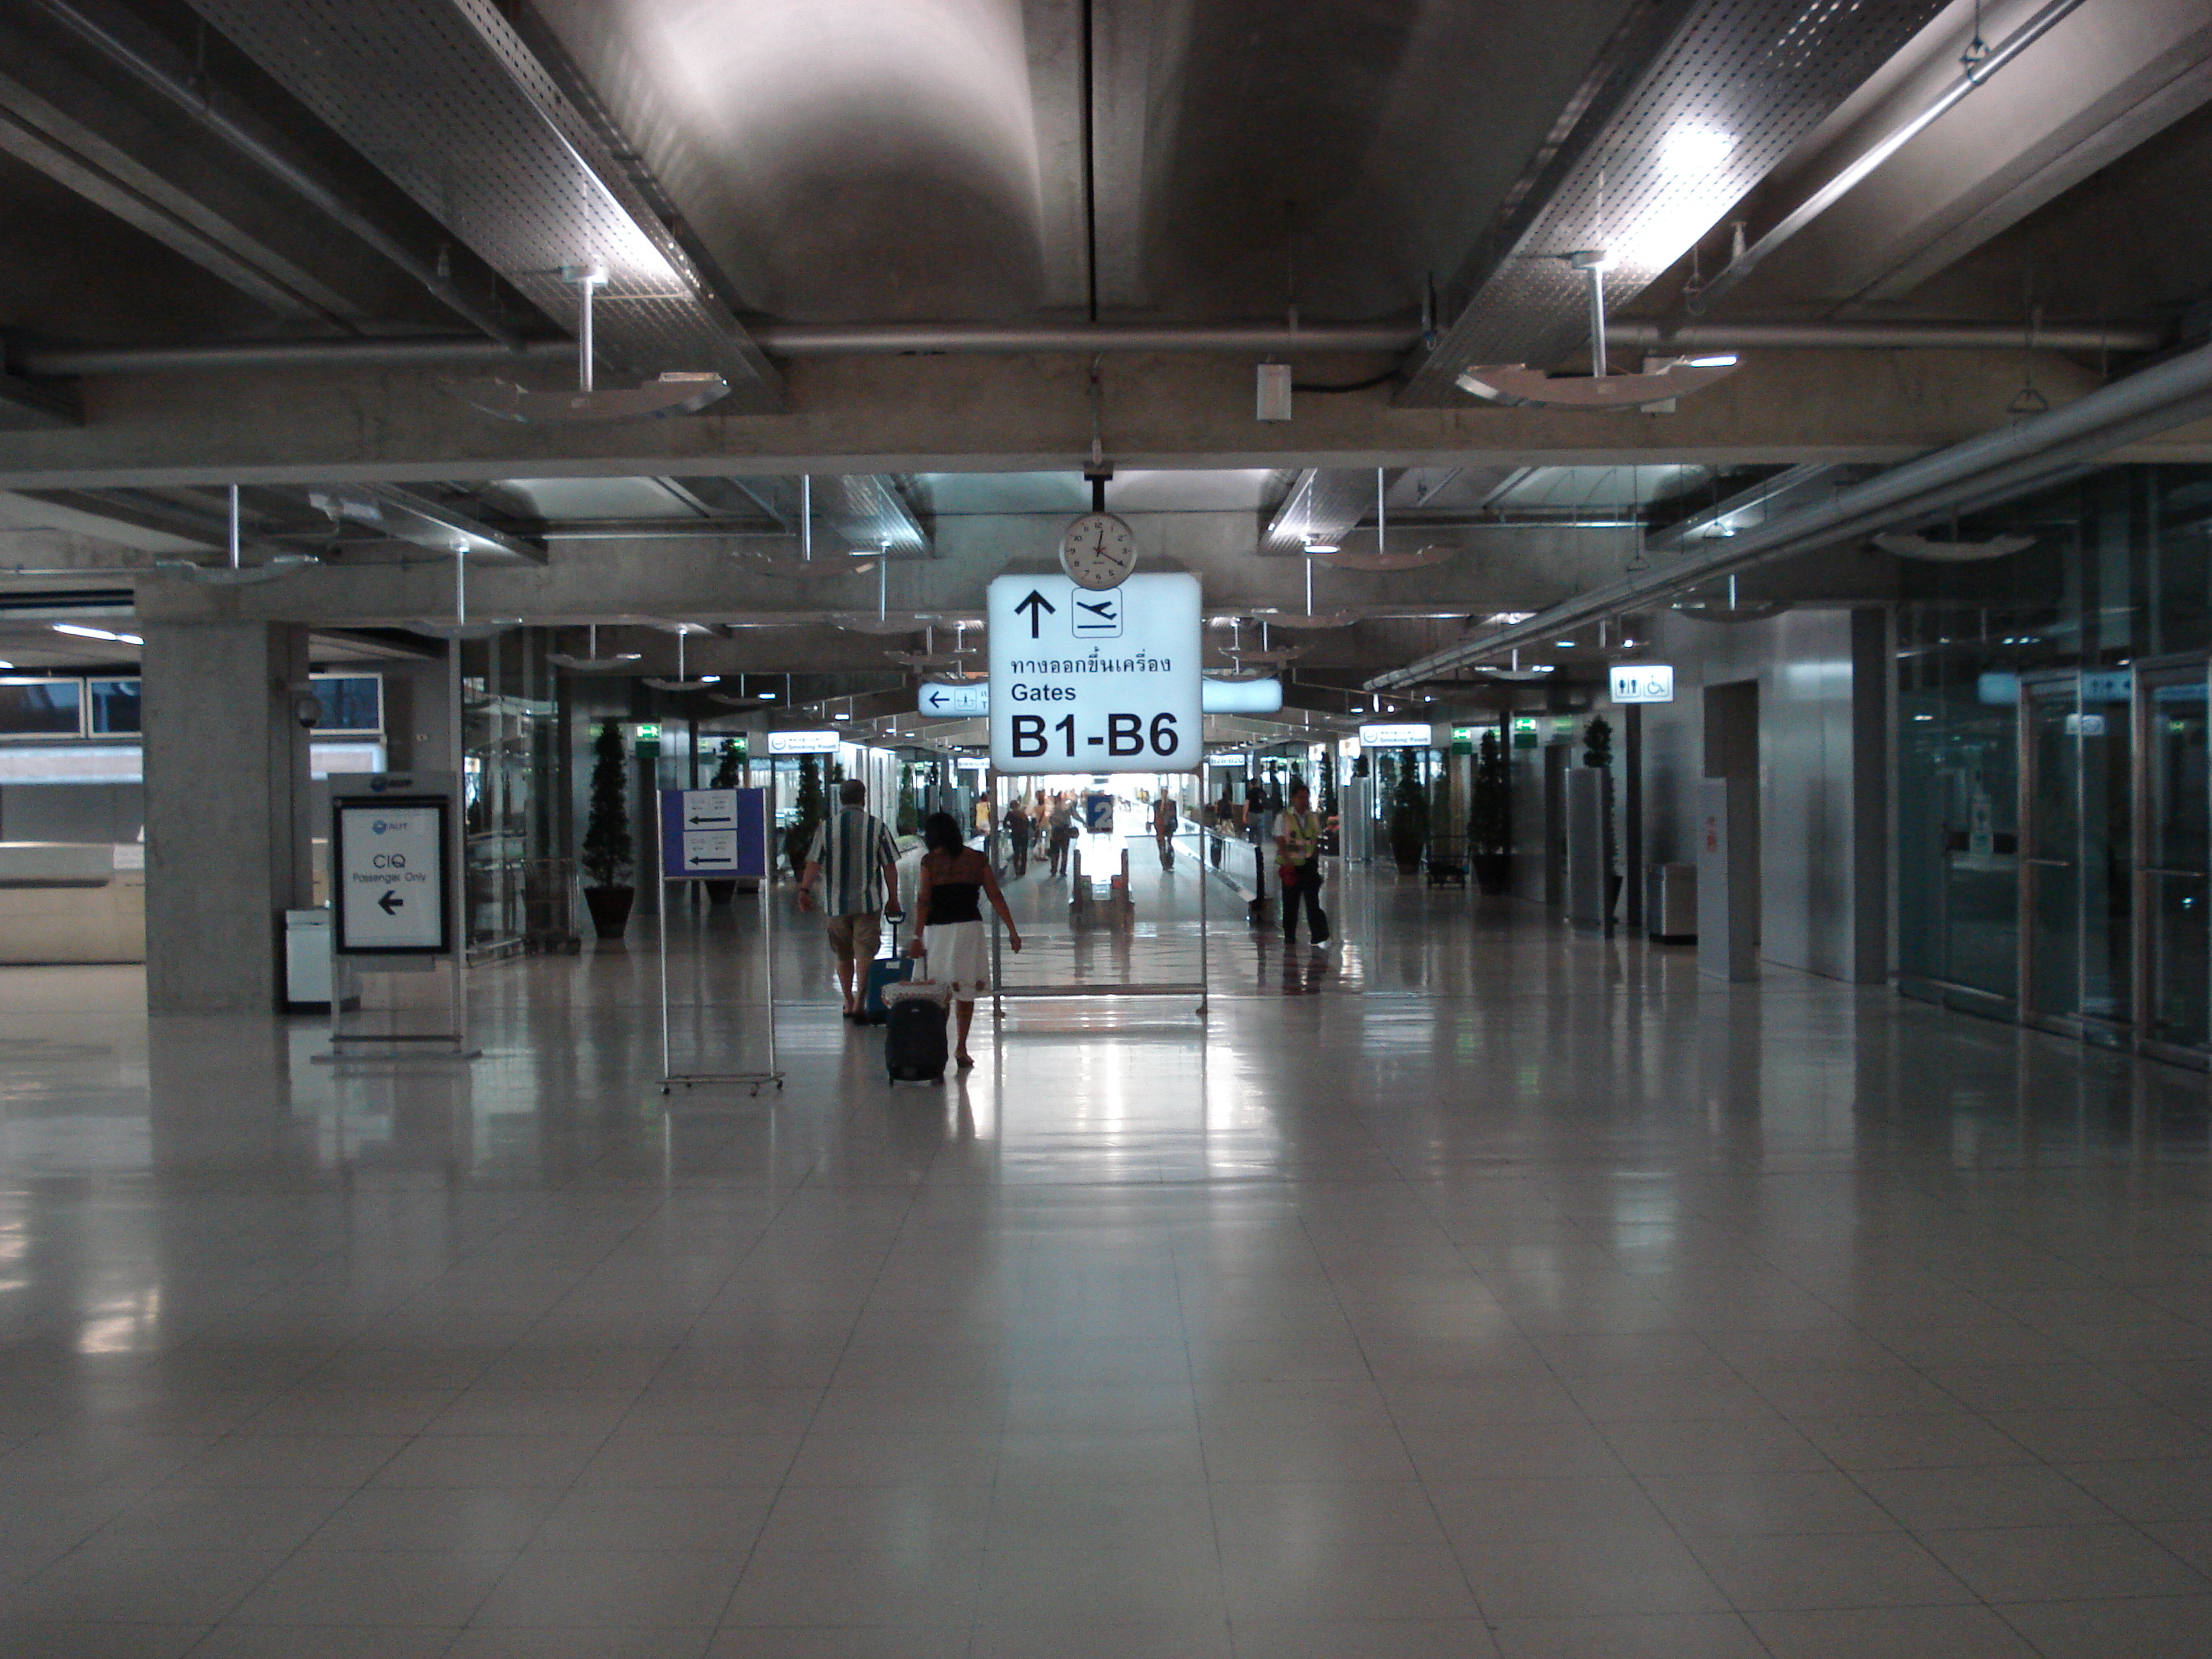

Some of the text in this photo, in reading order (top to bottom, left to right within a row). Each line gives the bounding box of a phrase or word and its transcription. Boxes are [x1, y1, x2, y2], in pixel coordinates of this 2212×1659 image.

[1010, 647, 1172, 674] ทางออกขึ้นเครื่อง
[1011, 683, 1076, 701] Gates
[1011, 712, 1179, 758] B1-B6
[1094, 801, 1113, 828] 2
[373, 854, 406, 869] CIQ
[405, 872, 426, 883] Only
